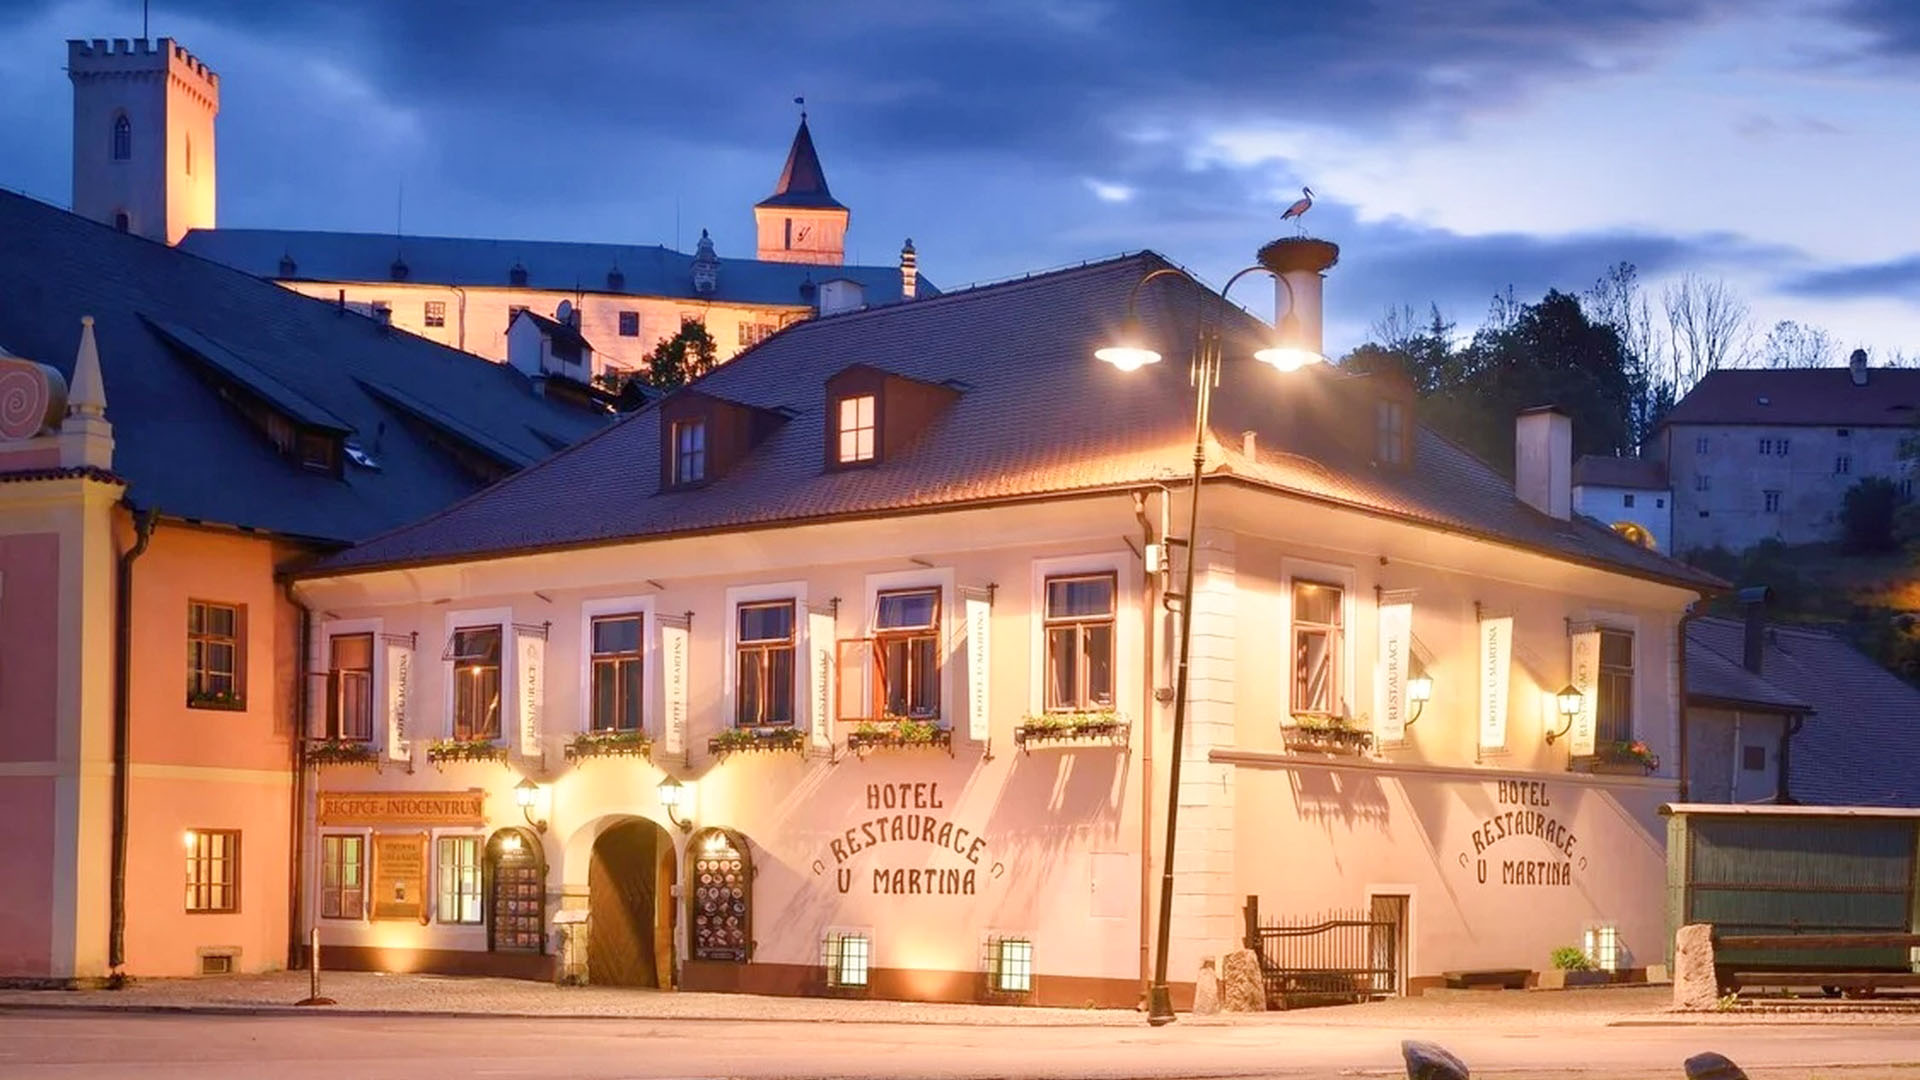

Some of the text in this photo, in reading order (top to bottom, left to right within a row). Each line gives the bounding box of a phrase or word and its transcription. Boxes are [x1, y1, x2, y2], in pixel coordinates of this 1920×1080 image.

[867, 782, 943, 809] HOTEL
[1498, 780, 1550, 806] HOTEL
[325, 800, 377, 815] RECEPCE
[386, 800, 482, 816] INFOCENTRUM
[830, 815, 986, 865] RESTAURACE
[1471, 811, 1576, 858] RESTAURACE
[837, 868, 976, 895] U MARTINA
[1477, 859, 1571, 886] U MARTINA
